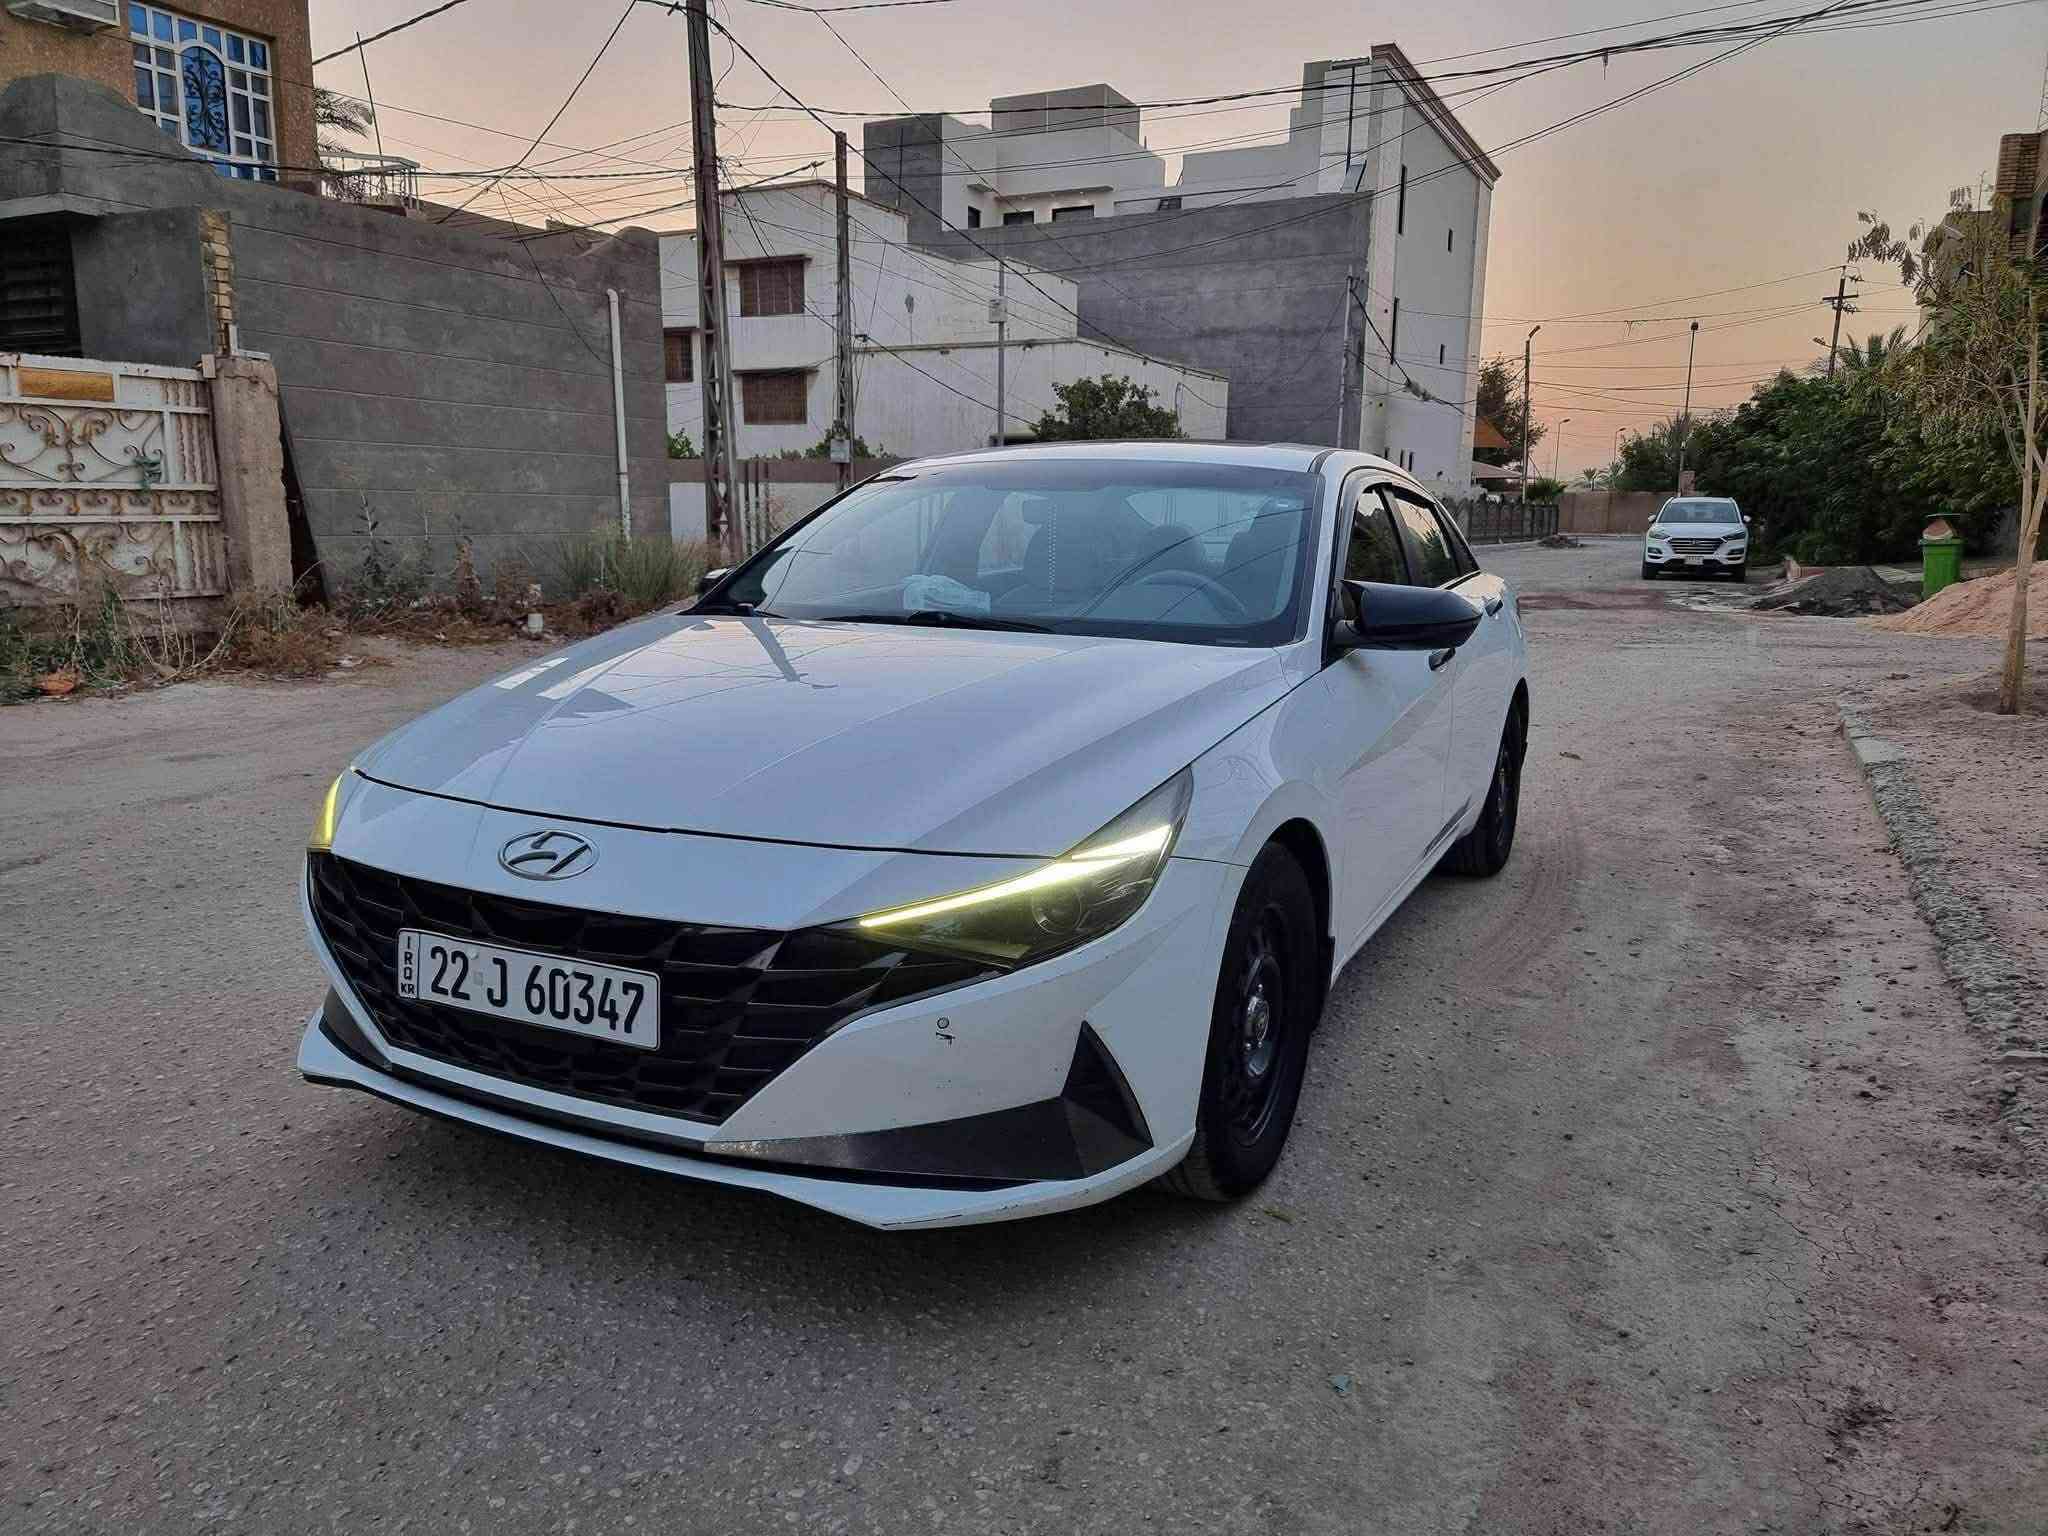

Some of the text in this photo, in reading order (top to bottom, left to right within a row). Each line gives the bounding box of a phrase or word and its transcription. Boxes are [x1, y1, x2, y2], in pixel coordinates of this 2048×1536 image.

[403, 935, 413, 981] IRQ
[400, 982, 415, 994] KR
[430, 946, 645, 1034] 22 J 60347
